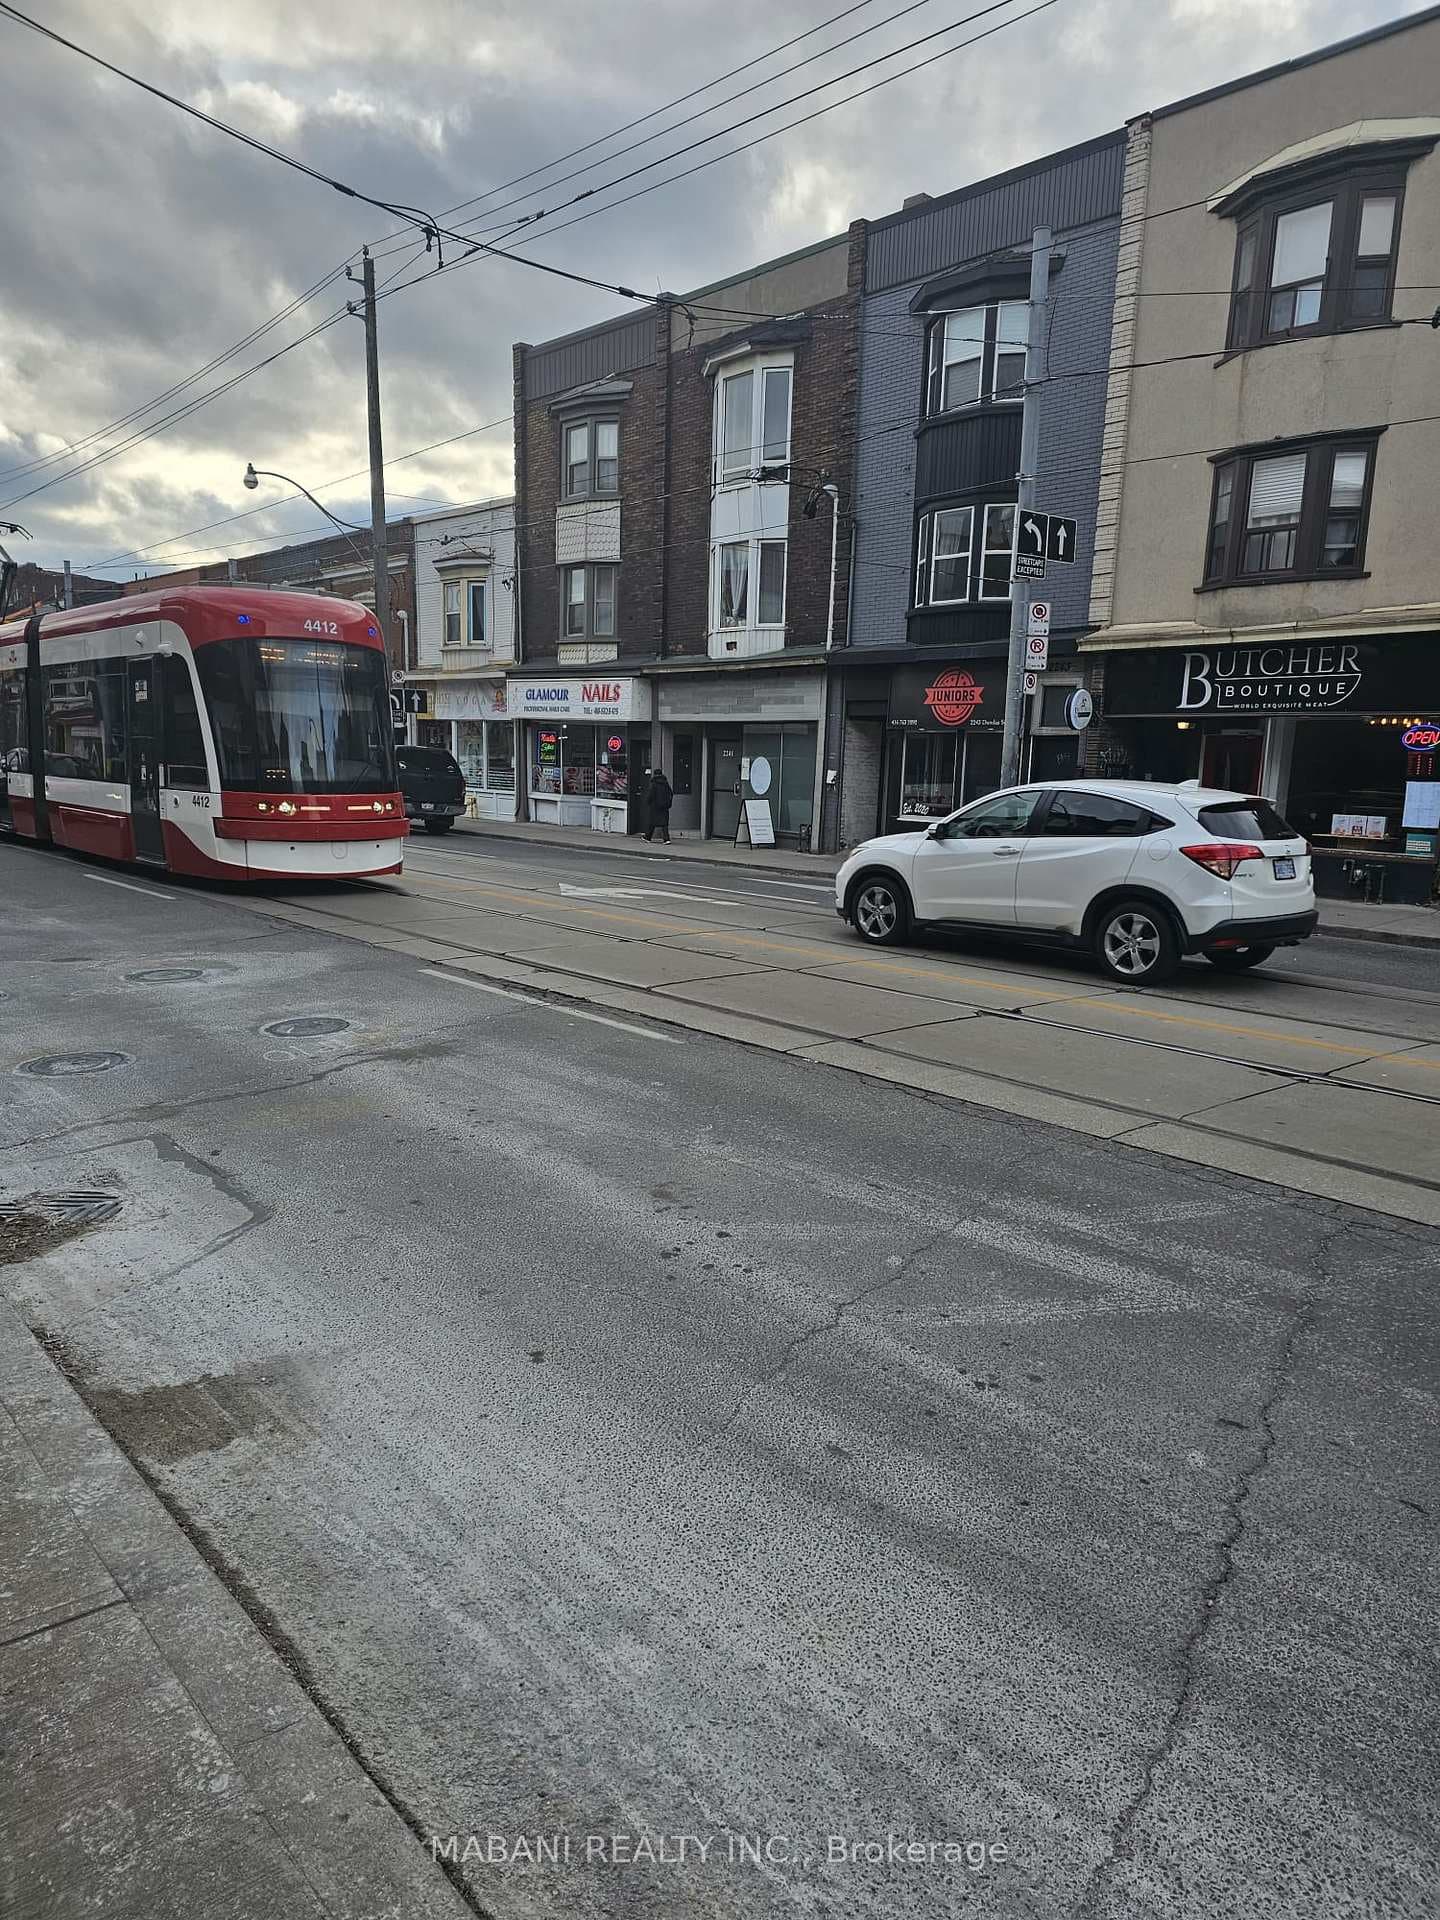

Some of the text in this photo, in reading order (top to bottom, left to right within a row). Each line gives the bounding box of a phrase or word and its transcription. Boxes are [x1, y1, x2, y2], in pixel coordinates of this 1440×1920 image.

[1017, 565, 1043, 576] EXCEPTED
[304, 619, 338, 634] 4412
[1176, 645, 1362, 709] BUTCHER
[525, 683, 622, 702] GLAMOUR NAILS
[932, 690, 975, 702] JUNIORS
[1225, 682, 1346, 697] BOUTIQUE
[1405, 731, 1440, 744] OPEN
[192, 796, 210, 808] 4412
